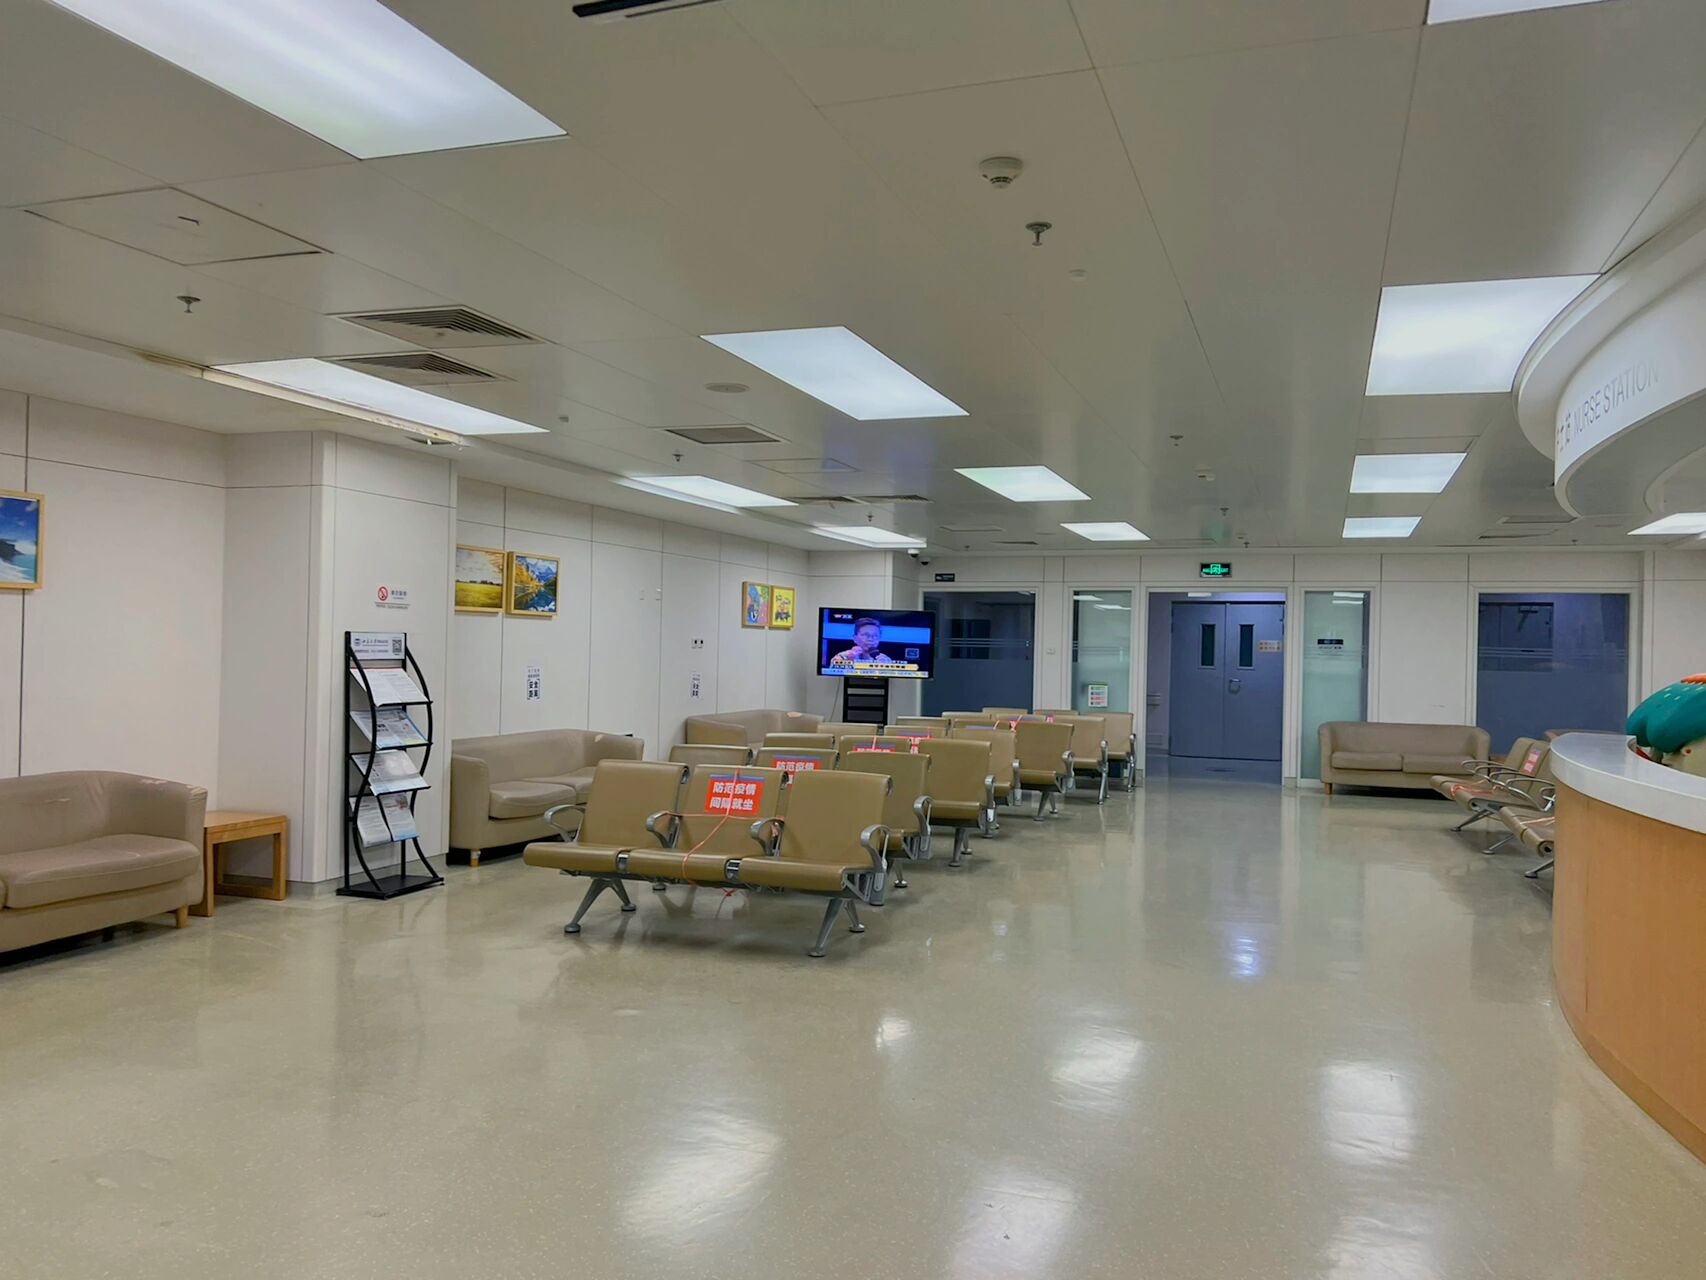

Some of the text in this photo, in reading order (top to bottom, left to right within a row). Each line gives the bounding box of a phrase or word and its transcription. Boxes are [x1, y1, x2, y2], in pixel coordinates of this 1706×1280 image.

[1573, 390, 1601, 438] NURSE
[1603, 357, 1659, 413] STATION
[712, 782, 756, 796] 防范疫情
[709, 796, 754, 810] 间隔就坐
